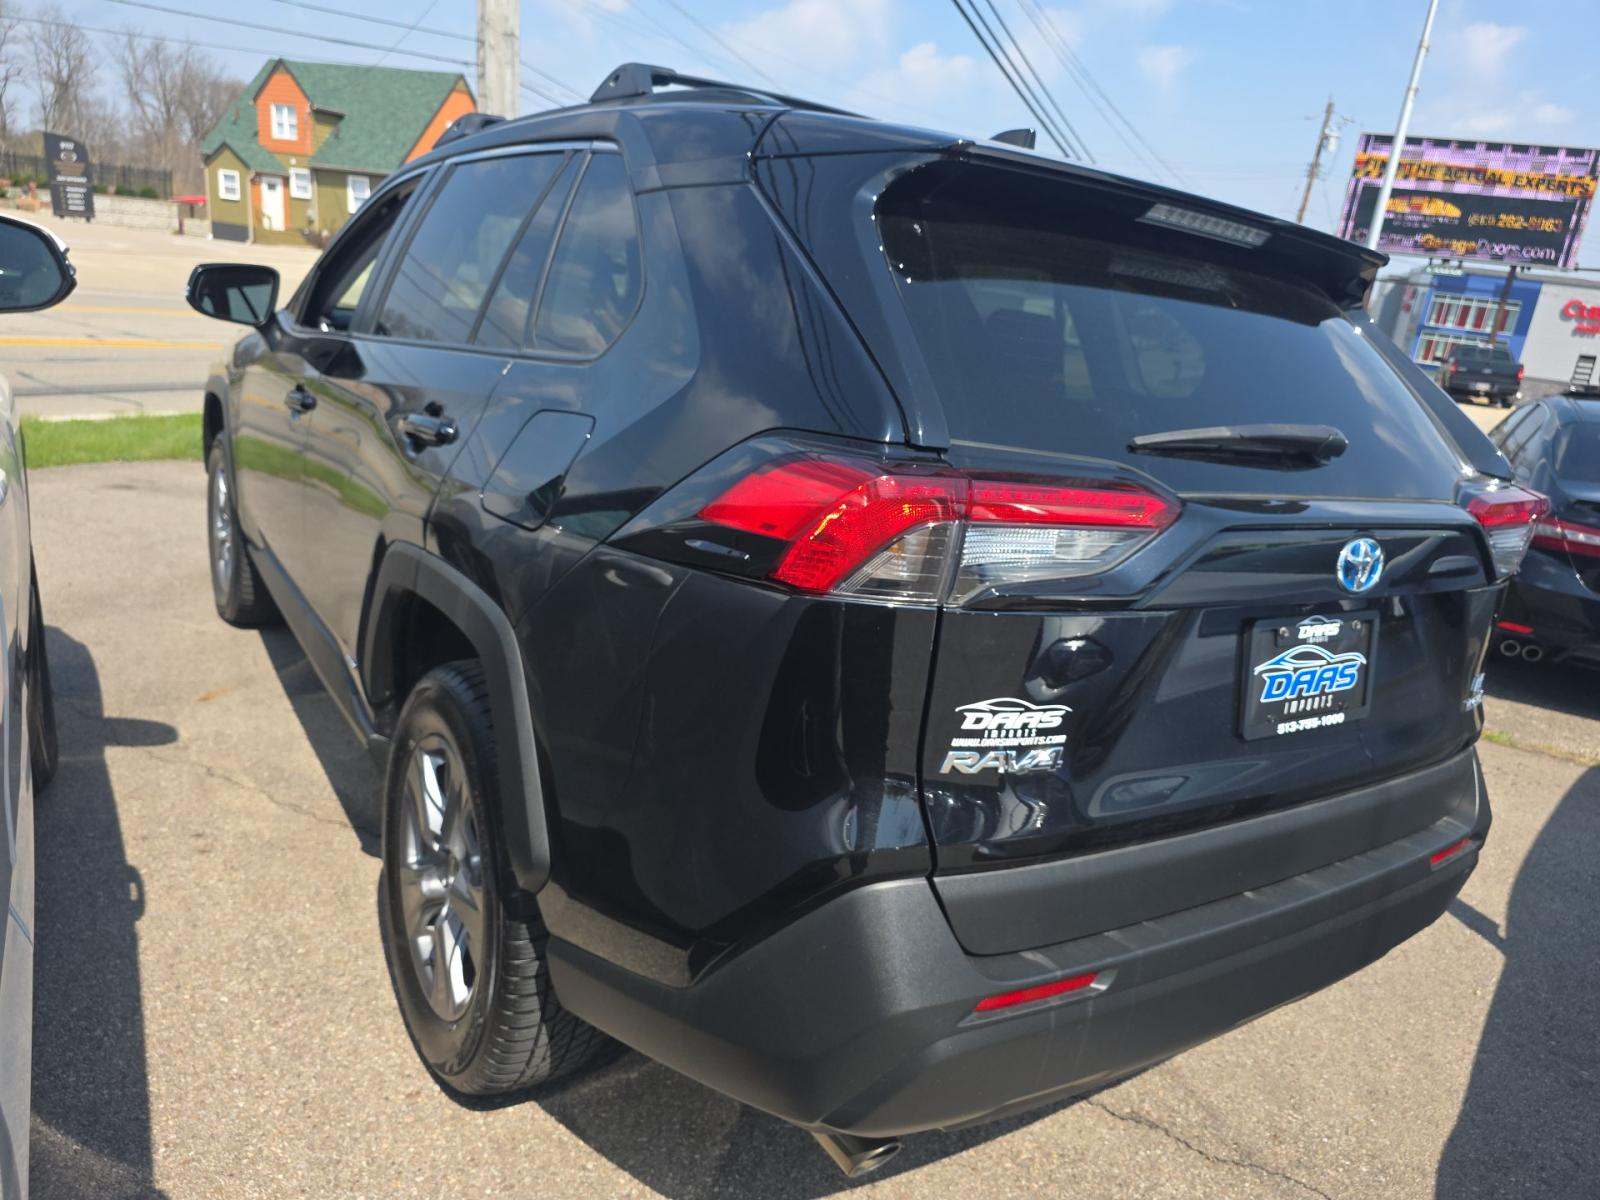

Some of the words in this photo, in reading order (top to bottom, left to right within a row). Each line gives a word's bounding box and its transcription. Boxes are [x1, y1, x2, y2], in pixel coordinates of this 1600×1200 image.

[1513, 174, 1591, 196] EXPERTS
[1298, 622, 1341, 639] DAAS
[1260, 660, 1361, 703] DAAS
[1283, 694, 1333, 714] IMPORTS
[960, 710, 1067, 730] DAAS
[984, 728, 1037, 738] IMPORTS
[939, 746, 1064, 775] RAV4
